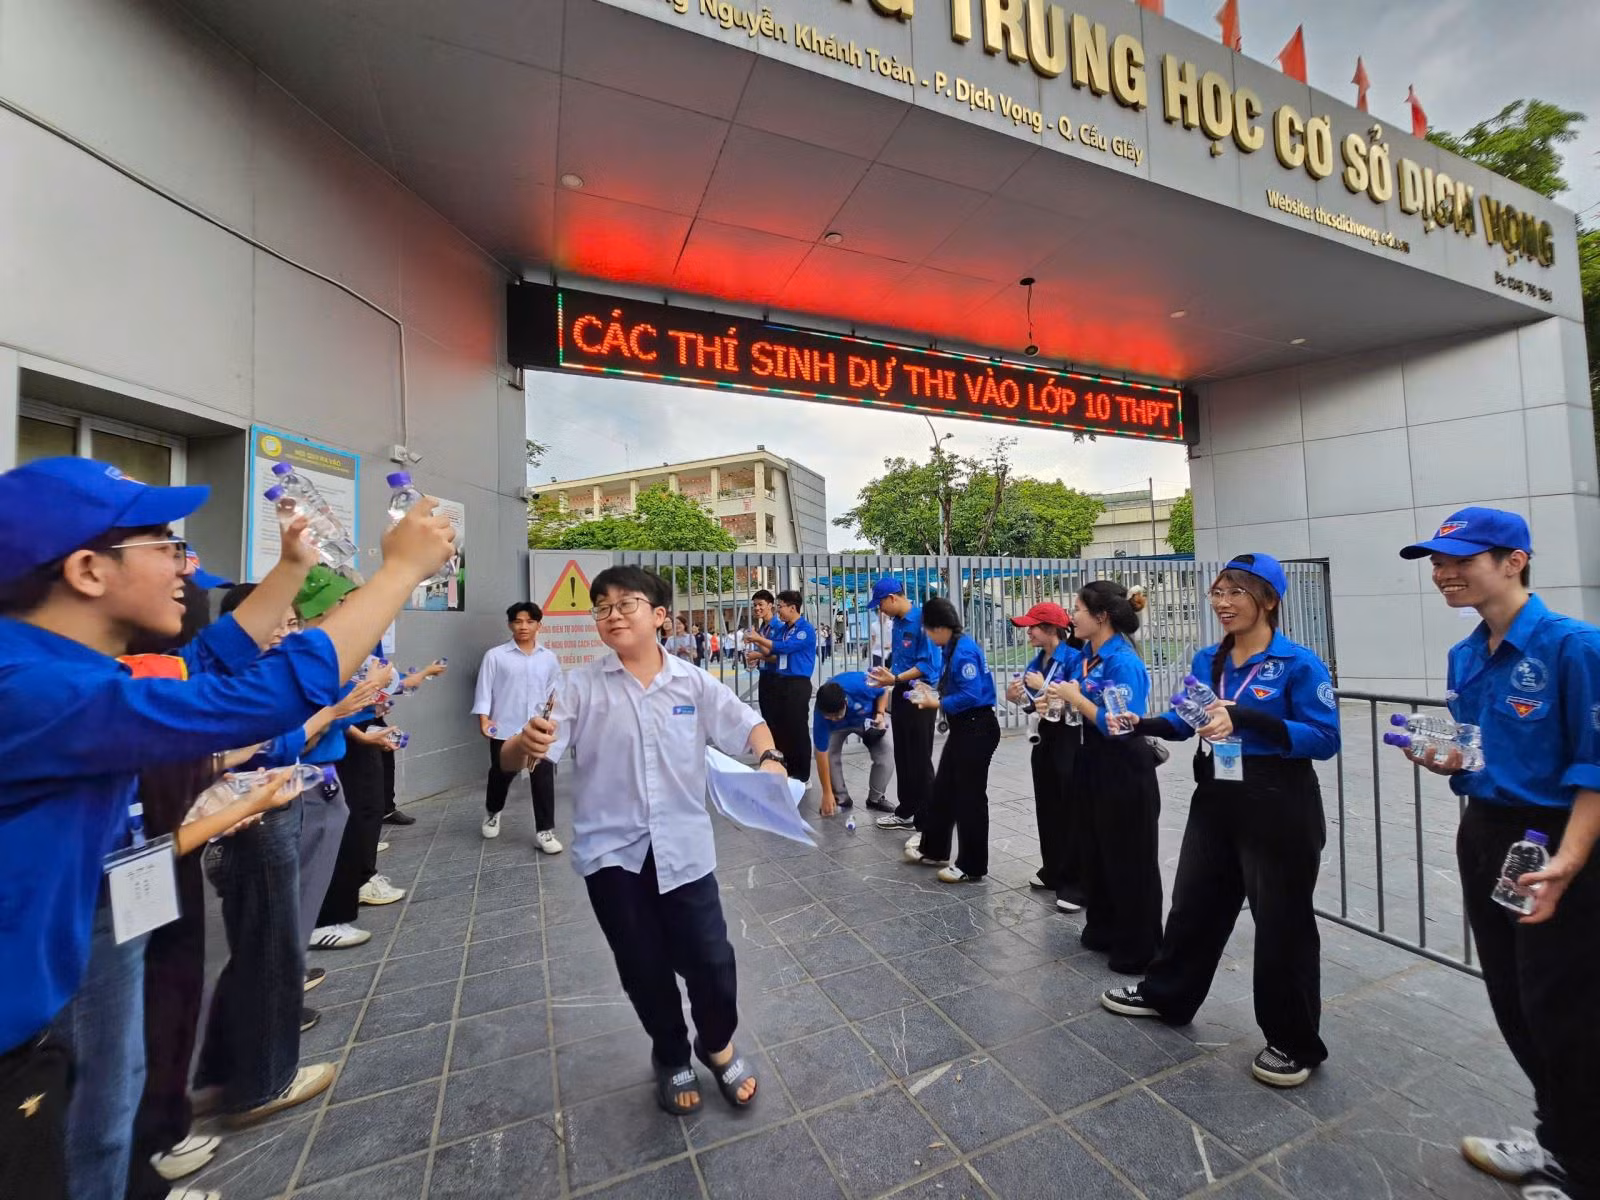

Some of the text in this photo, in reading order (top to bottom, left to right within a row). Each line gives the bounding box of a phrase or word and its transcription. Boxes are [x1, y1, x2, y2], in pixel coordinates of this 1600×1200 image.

[795, 23, 863, 69] Khánh
[865, 47, 915, 86] Toàn
[934, 70, 952, 98] P.
[955, 77, 995, 111] Dịch
[998, 92, 1043, 134] Vọng
[1058, 115, 1077, 141] Q.
[1162, 53, 1265, 157] HỌC
[1274, 104, 1334, 180] CƠ
[1341, 123, 1394, 203] SỞ
[1398, 158, 1475, 237] DỊCH
[1266, 189, 1314, 221] Website:
[573, 308, 1175, 428] CÁC THÍ SINH DỰ THI VÀO LỚP 10 THPT
